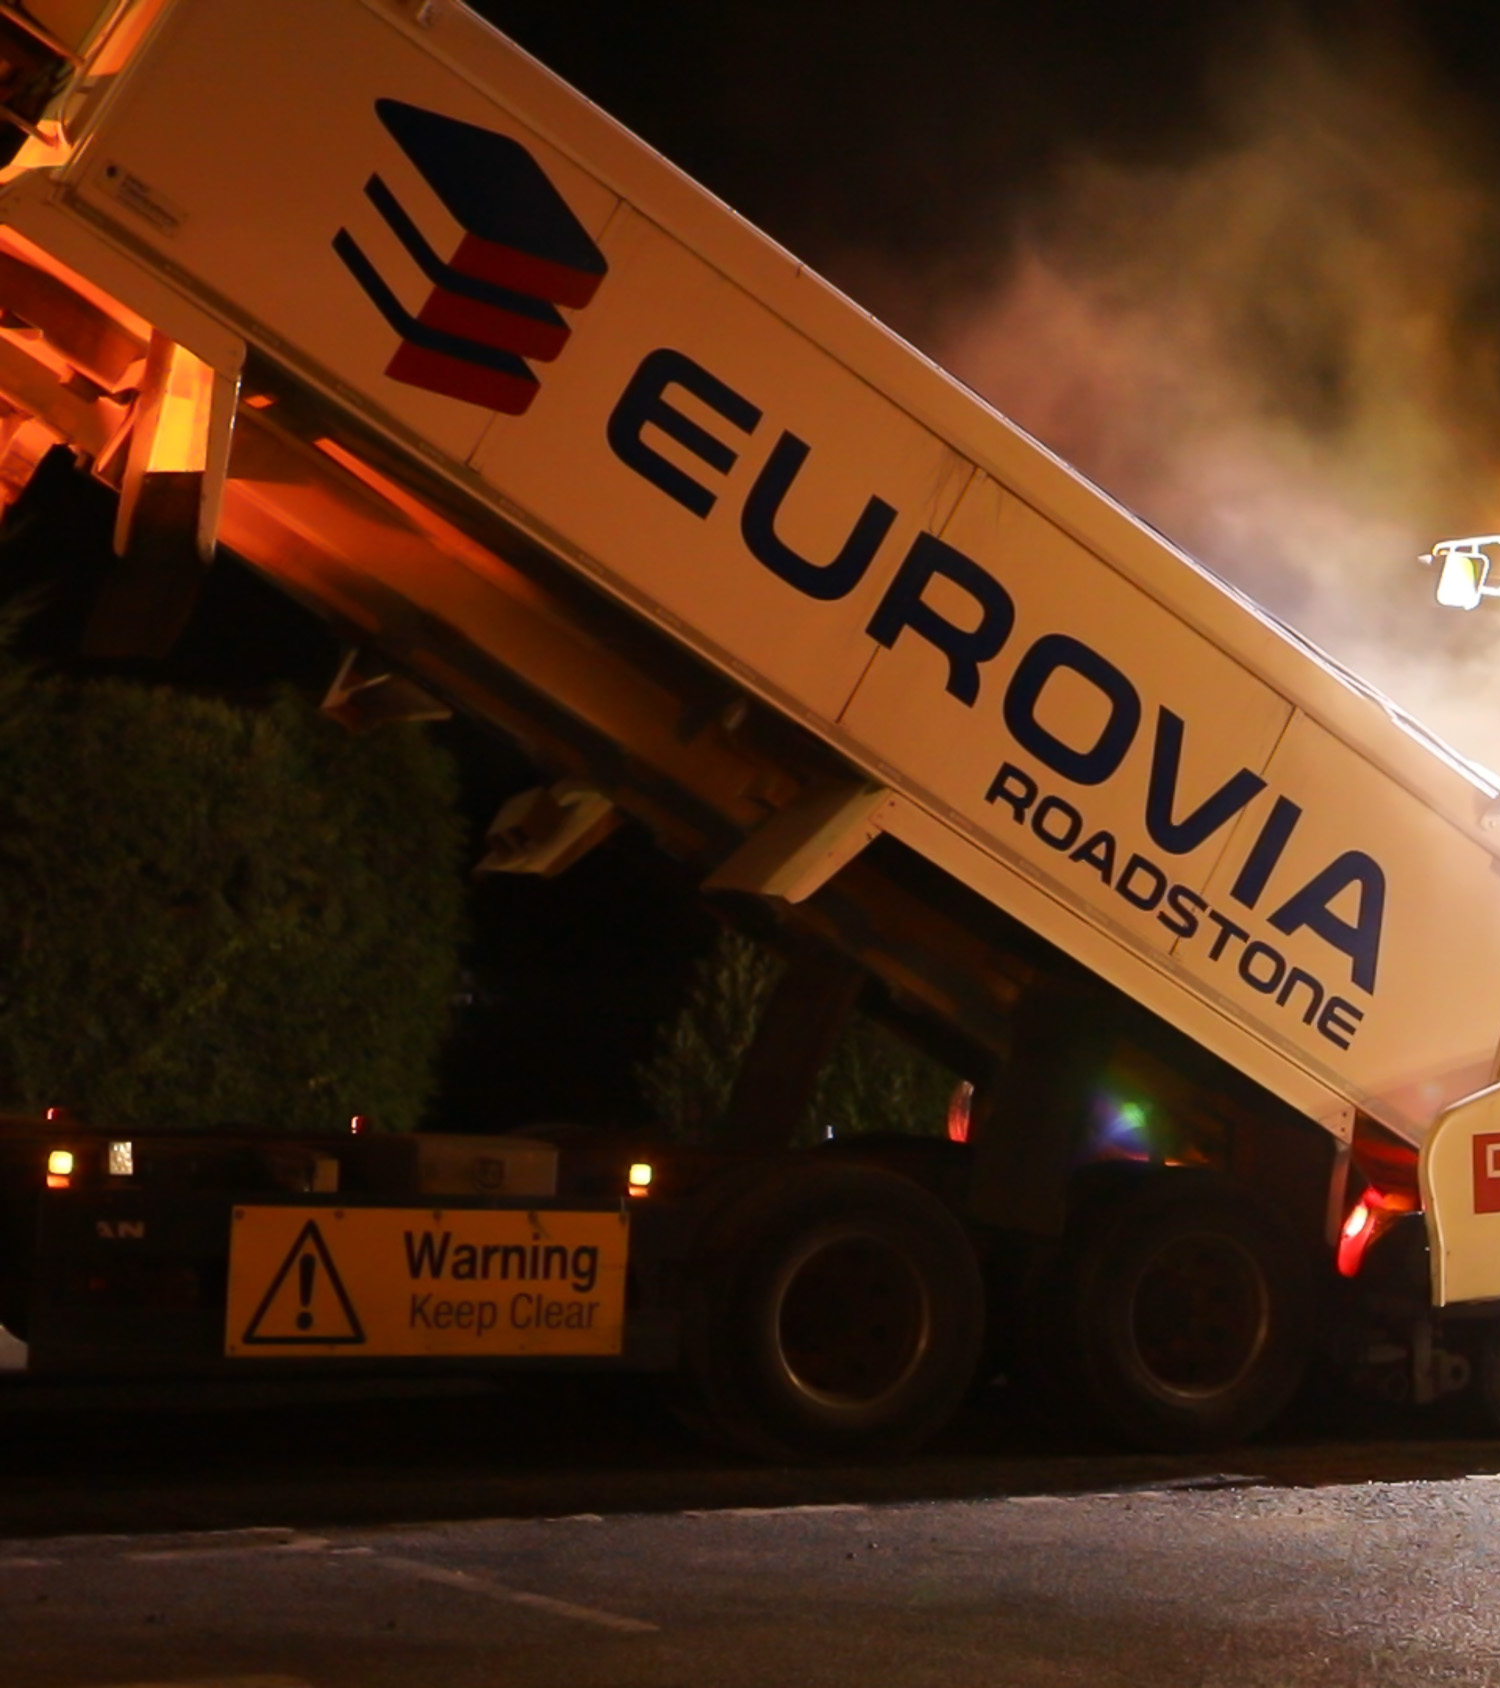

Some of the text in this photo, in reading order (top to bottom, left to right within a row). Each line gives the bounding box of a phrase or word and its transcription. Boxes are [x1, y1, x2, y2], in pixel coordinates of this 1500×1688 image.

[606, 347, 1387, 997] EUROVIA
[984, 762, 1365, 1051] ROADSTONE
[403, 1230, 599, 1293] Warning
[409, 1292, 601, 1337] Keep Clear
